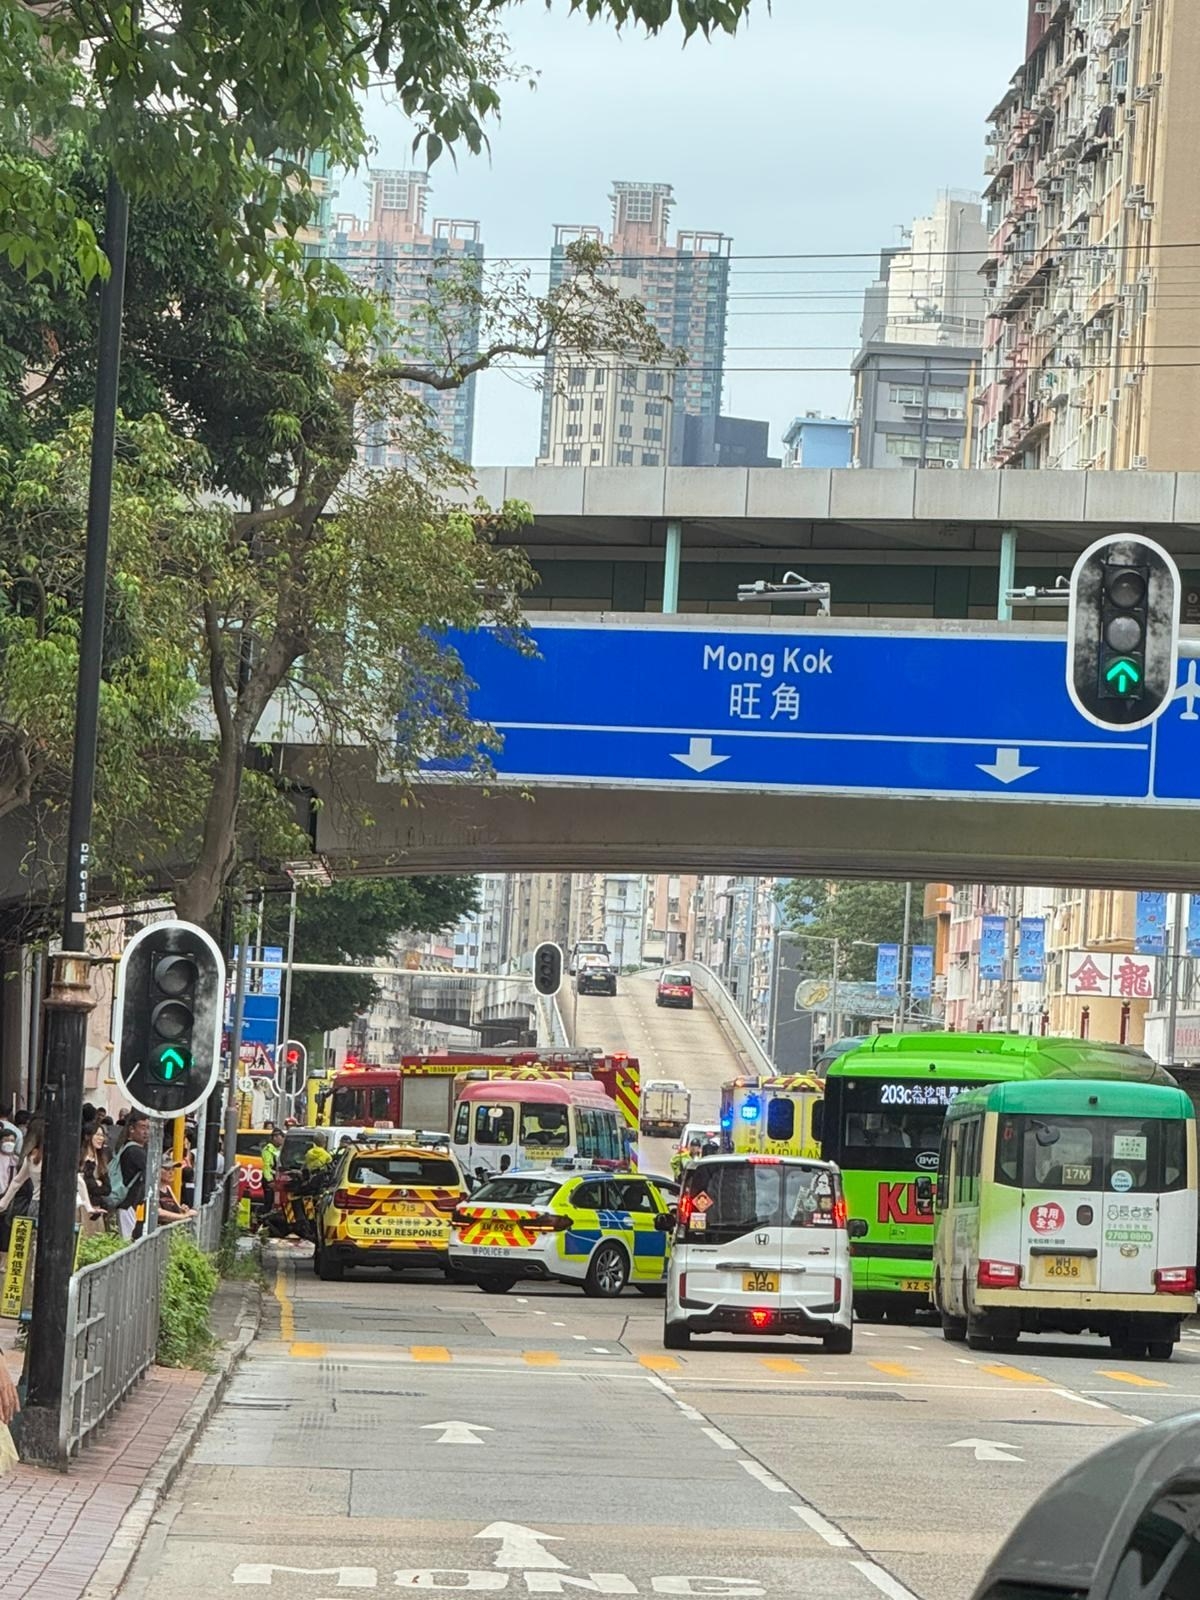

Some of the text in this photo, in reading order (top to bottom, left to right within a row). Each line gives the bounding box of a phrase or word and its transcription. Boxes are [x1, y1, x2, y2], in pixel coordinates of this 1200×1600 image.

[702, 644, 833, 679] Mong Kok
[729, 682, 800, 721] 旺角
[1070, 955, 1153, 997] 金龍
[1065, 1168, 1091, 1180] 17M
[364, 1227, 443, 1238] RAPID RESPONSE
[478, 1247, 502, 1257] POLICE
[1056, 1258, 1071, 1267] WH
[1048, 1266, 1079, 1277] 4038
[748, 1281, 774, 1292] 5120
[230, 1562, 769, 1598] MONG
